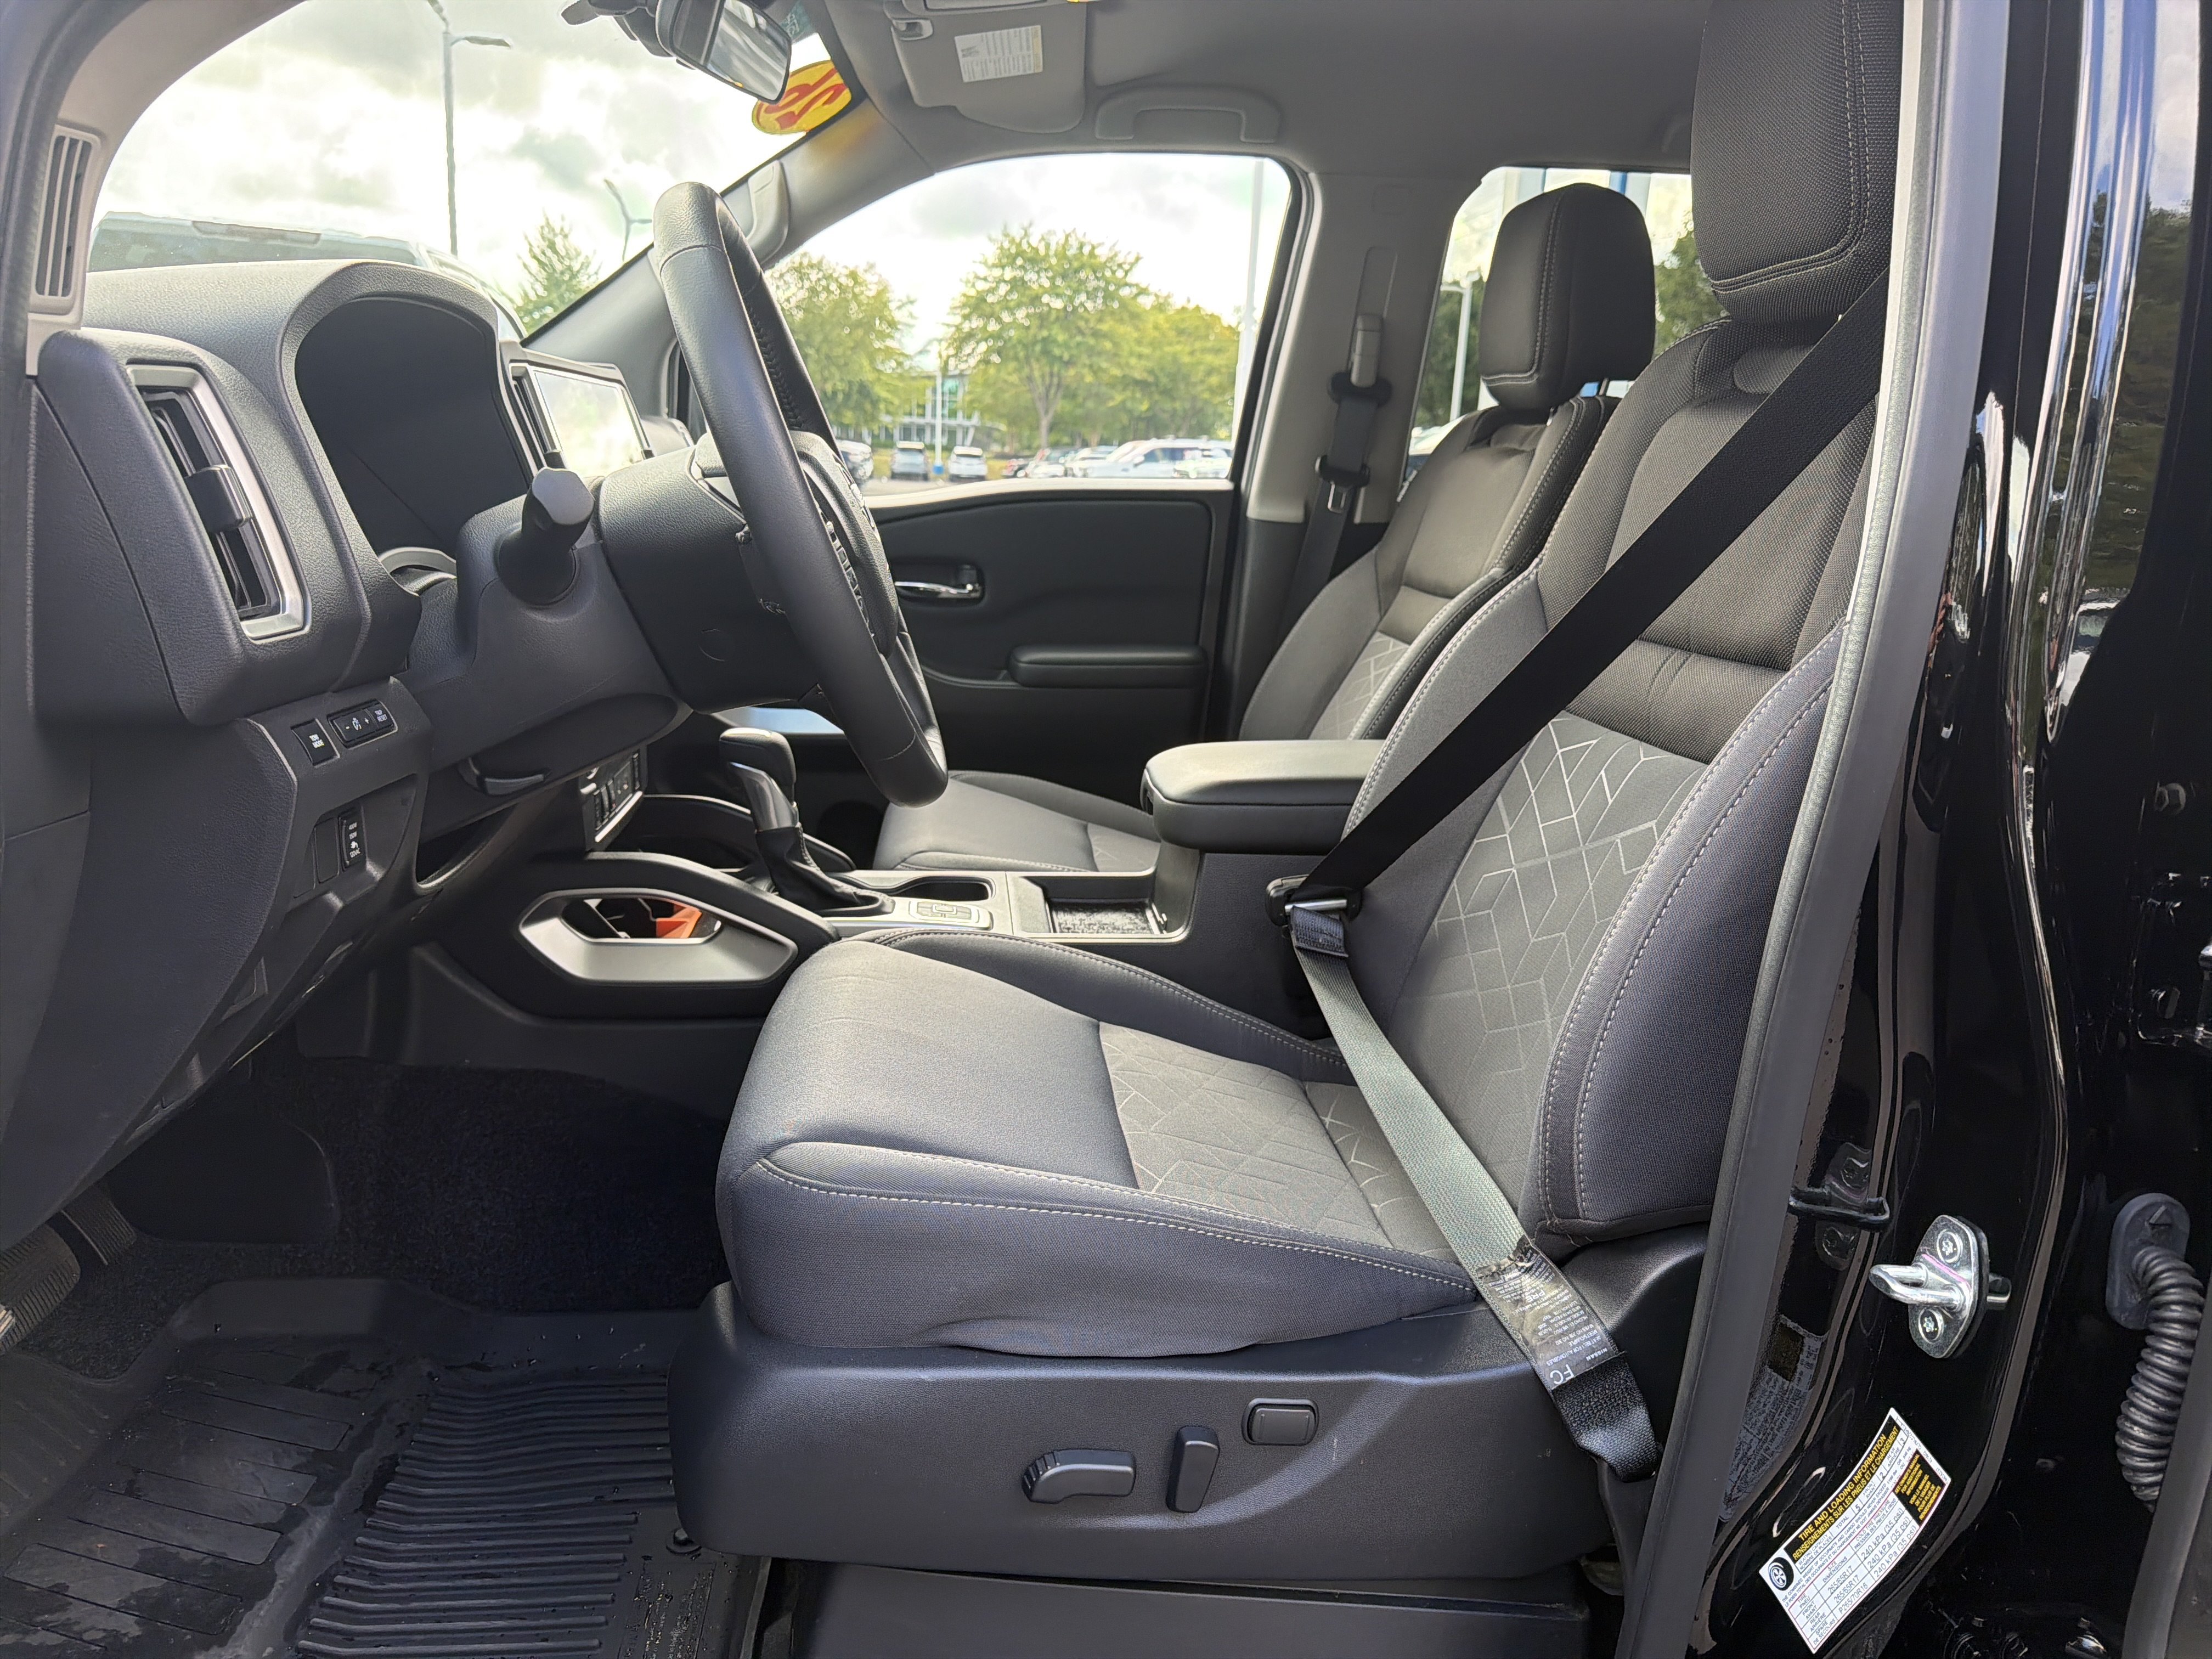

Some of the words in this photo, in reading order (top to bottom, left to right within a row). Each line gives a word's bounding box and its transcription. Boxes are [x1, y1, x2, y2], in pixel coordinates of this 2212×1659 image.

[1525, 1289, 1545, 1304] PRE
[1572, 1345, 1582, 1353] FOR
[1581, 1340, 1591, 1349] BELT
[1590, 1334, 1601, 1344] SEAT
[1545, 1349, 1573, 1367] AUTOMOBILES
[1585, 1346, 1608, 1361] NISSAN
[1548, 1363, 1575, 1387] FC
[1899, 1437, 1906, 1445] 3
[1886, 1446, 1895, 1460] REAR
[1878, 1471, 1886, 1479] 2
[1899, 1468, 1911, 1487] OWNER'S
[1909, 1453, 1920, 1469] MANUAL
[1905, 1462, 1921, 1485] ADDITIONAL
[1792, 1515, 1835, 1561] RENSEIGNEMENTS
[1832, 1504, 1845, 1519] SUR
[1842, 1494, 1854, 1508] LES
[1850, 1477, 1866, 1498] PNEUS
[1864, 1470, 1872, 1480] ET
[1869, 1463, 1878, 1474] LE
[1875, 1425, 1899, 1466] CHARGEMENT
[1798, 1523, 1815, 1541] TIRE
[1813, 1509, 1829, 1527] AND
[1826, 1481, 1855, 1513] LOADING
[1853, 1433, 1887, 1485] INFORMATION
[1862, 1480, 1875, 1496] FRONT
[1865, 1483, 1877, 1499] AVANT
[1905, 1468, 1923, 1496] INFORMATION
[1909, 1493, 1917, 1505] VOIR
[1915, 1487, 1920, 1496] LE
[1918, 1472, 1929, 1490] MANUEL
[1854, 1503, 1861, 1511] 5
[1914, 1498, 1920, 1506] DE
[1917, 1499, 1926, 1512] POUR
[1923, 1489, 1932, 1502] PLUS
[1930, 1483, 1936, 1492] DE
[1918, 1485, 1942, 1520] RENSEIGNEMENTS
[1787, 1577, 1803, 1596] COMBINED
[1802, 1565, 1815, 1579] WEIGHT
[1818, 1541, 1838, 1562] OCCUPANTS
[1836, 1533, 1844, 1543] AND
[1844, 1521, 1855, 1535] CARGO
[1855, 1508, 1867, 1523] SHOULD
[1866, 1497, 1877, 1509] NEVER
[1875, 1482, 1887, 1498] EXCEED
[1895, 1457, 1903, 1466] OR
[1835, 1515, 1849, 1529] TOTAL
[1854, 1531, 1870, 1550] PRESSION
[1869, 1523, 1877, 1533] DES
[1875, 1512, 1886, 1526] PNEUS
[1855, 1528, 1866, 1542] COLD
[1865, 1520, 1874, 1530] TIRE
[1873, 1499, 1891, 1521] PRESSURE
[1787, 1592, 1797, 1603] POIDS
[1796, 1582, 1805, 1594] TOTAL
[1810, 1558, 1829, 1578] OCCUPANTS
[1836, 1528, 1857, 1551] CHARGEMENT
[1859, 1516, 1867, 1525] DOIT
[1899, 1462, 1905, 1470] OU
[1861, 1544, 1874, 1560] 240
[1871, 1531, 1885, 1547] kPa
[1883, 1520, 1895, 1534] (35
[1891, 1506, 1904, 1523] psi)
[1867, 1553, 1880, 1569] 240
[1877, 1539, 1892, 1556] kPa
[1889, 1528, 1901, 1543] (35
[1898, 1515, 1911, 1532] psi)
[1797, 1549, 1813, 1566] SEATING
[1811, 1533, 1828, 1551] CAPACITY
[1799, 1554, 1814, 1571] NOMBRE
[1818, 1535, 1832, 1551] PLACES
[1873, 1562, 1887, 1578] 240
[1884, 1549, 1898, 1565] kPa
[1897, 1537, 1908, 1553] (35
[1905, 1524, 1918, 1541] psi)
[1822, 1555, 1848, 1583] DIMENSIONS
[1827, 1560, 1837, 1571] SIZE
[1827, 1565, 1855, 1595] 265/65R17
[1833, 1573, 1860, 1604] 265/65R17
[1797, 1593, 1807, 1604] TIRE
[1799, 1595, 1810, 1609] PNEU
[1802, 1600, 1815, 1616] FRONT
[1838, 1581, 1869, 1614] P265/70R16
[1805, 1604, 1818, 1620] AVANT
[1809, 1611, 1820, 1624] REAR
[1809, 1611, 1826, 1632] ARRIÈRE
[1812, 1635, 1820, 1645] DE
[1818, 1617, 1836, 1639] SECOURS
[1815, 1620, 1828, 1635] SPARE
